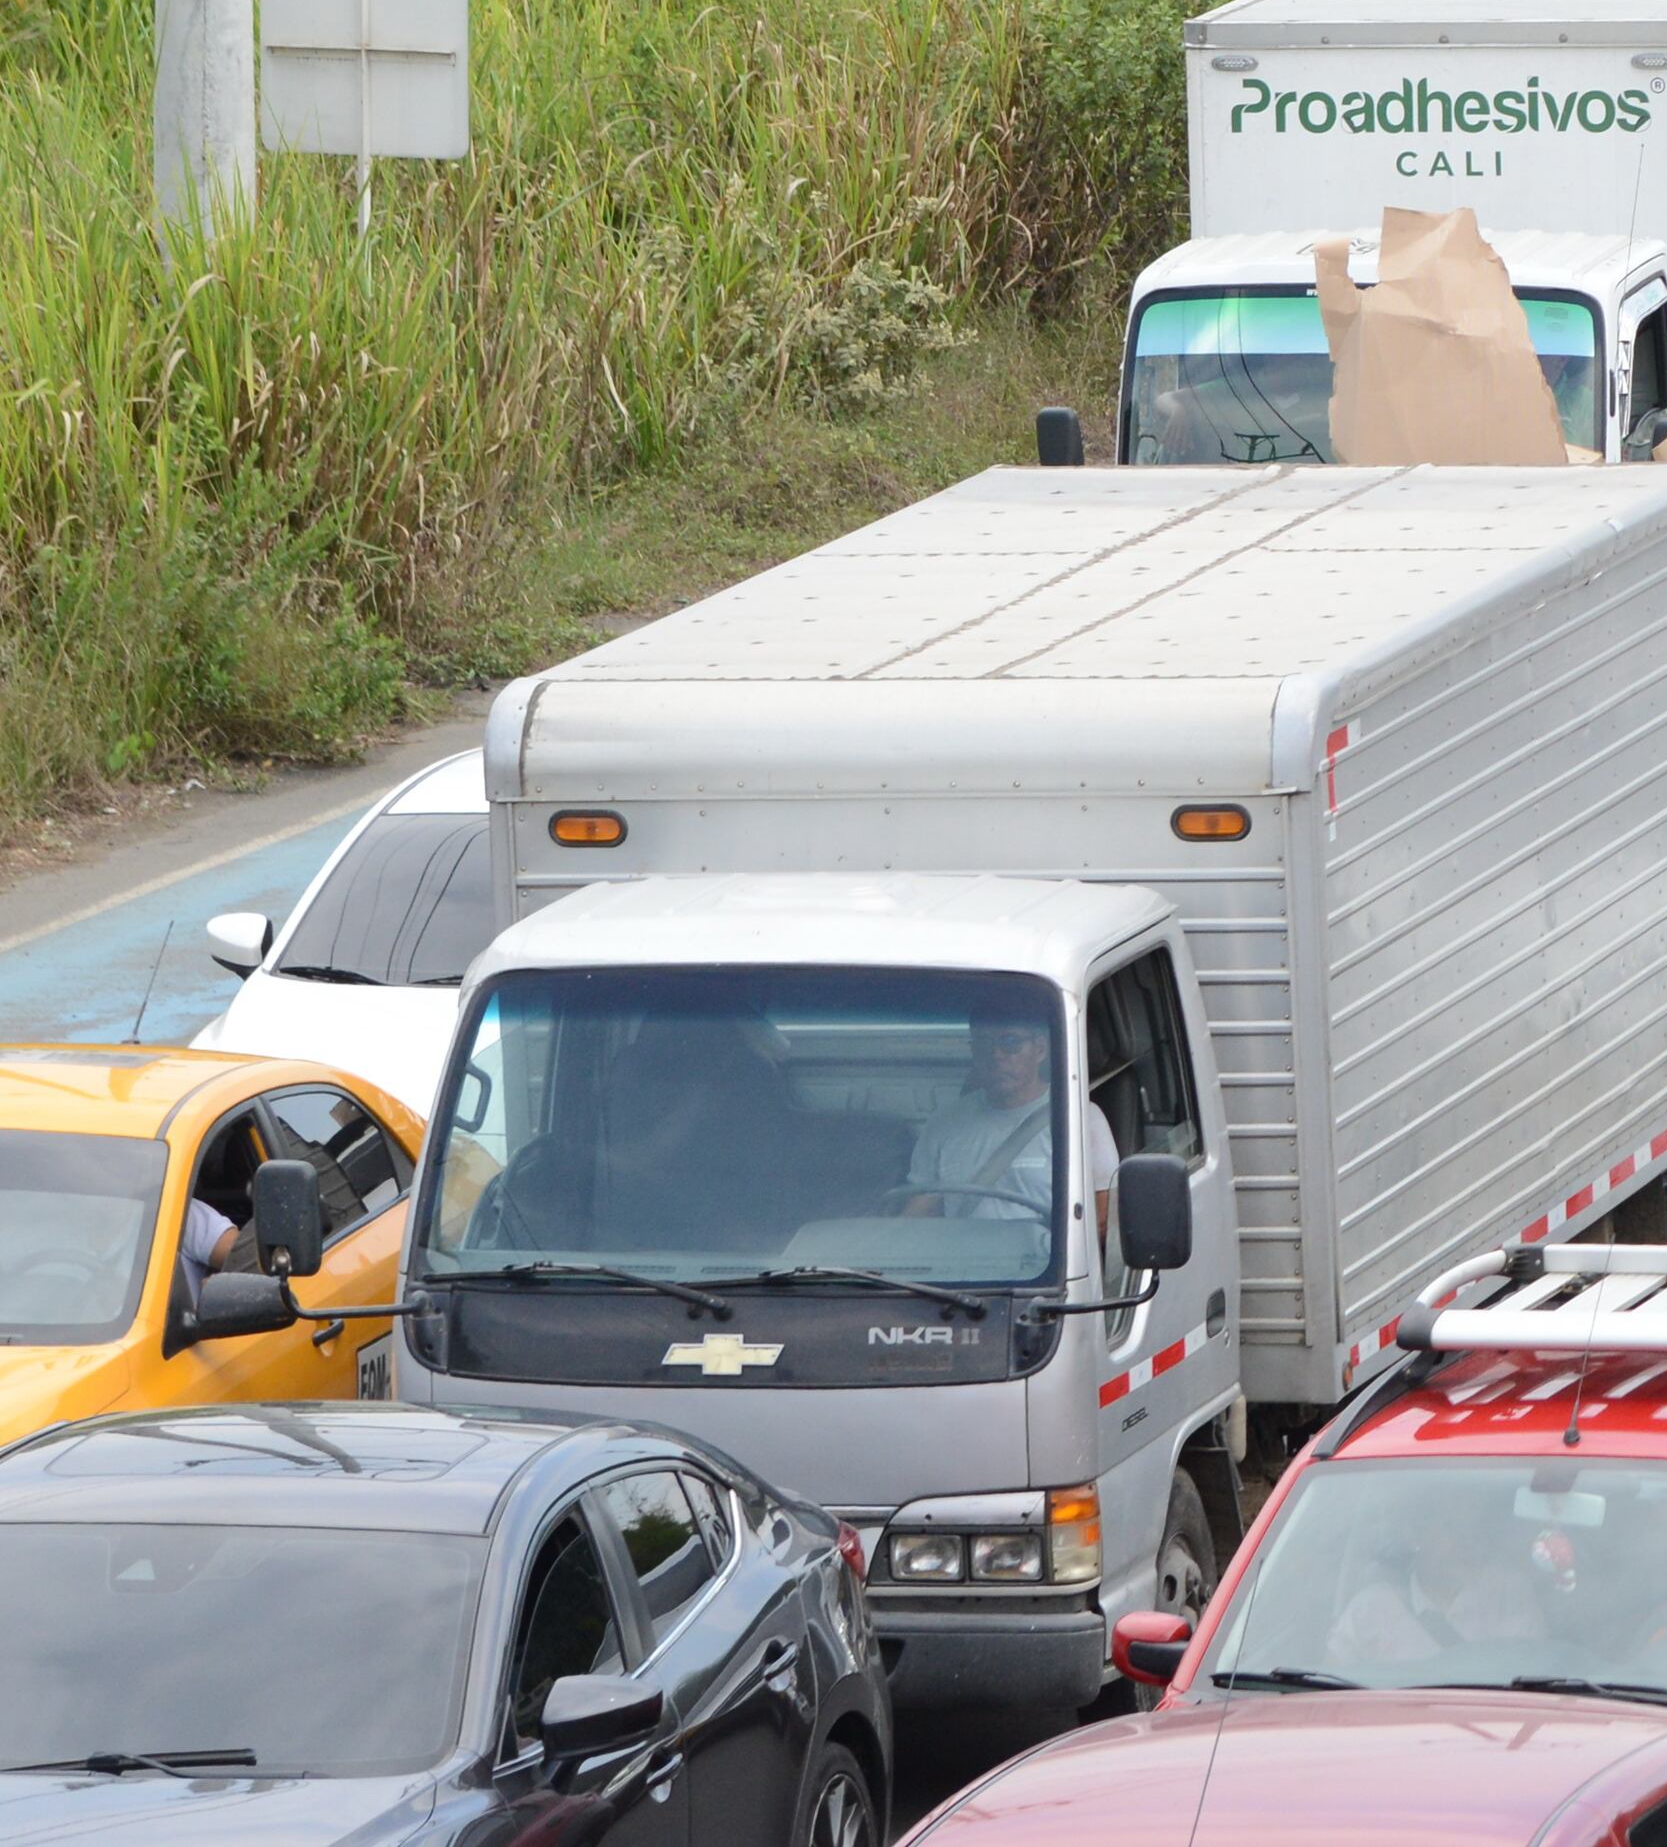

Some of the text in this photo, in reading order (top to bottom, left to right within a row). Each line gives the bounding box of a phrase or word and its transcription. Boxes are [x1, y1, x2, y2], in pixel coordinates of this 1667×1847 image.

[1231, 75, 1652, 134] Proadhesivos
[1396, 151, 1503, 178] CALI
[868, 1326, 980, 1345] NKR II
